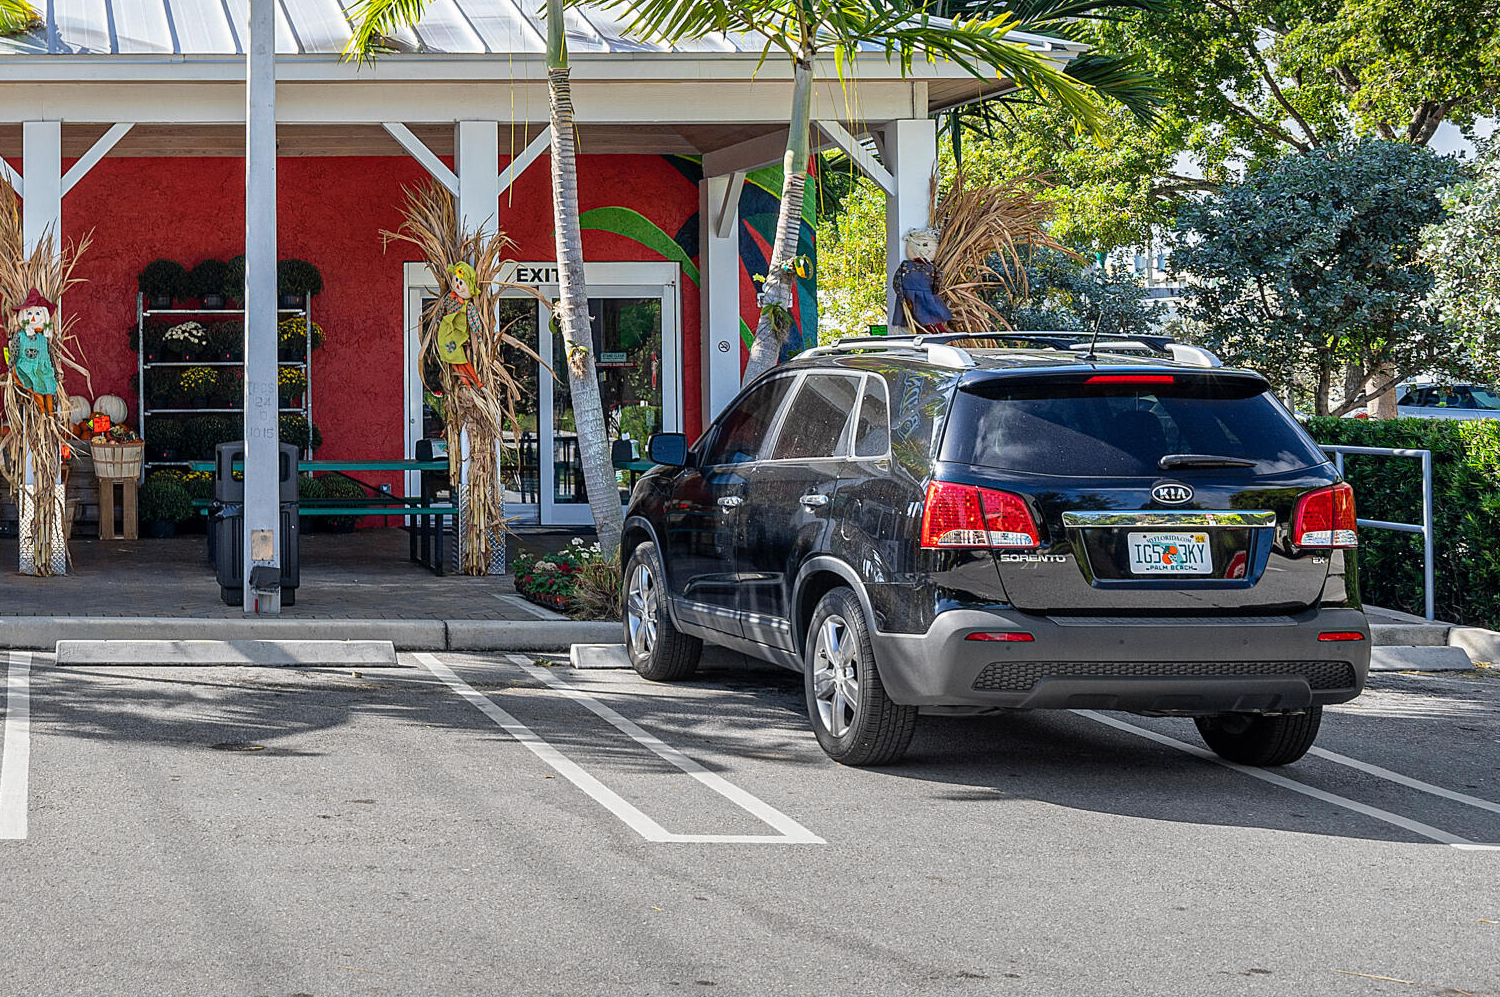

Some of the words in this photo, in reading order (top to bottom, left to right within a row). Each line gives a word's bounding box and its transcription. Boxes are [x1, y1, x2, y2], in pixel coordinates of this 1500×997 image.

[516, 267, 560, 283] EXIT
[1159, 488, 1187, 500] KIA
[1146, 535, 1192, 544] MYFLORIDA.COM
[1000, 554, 1067, 563] SORENTO
